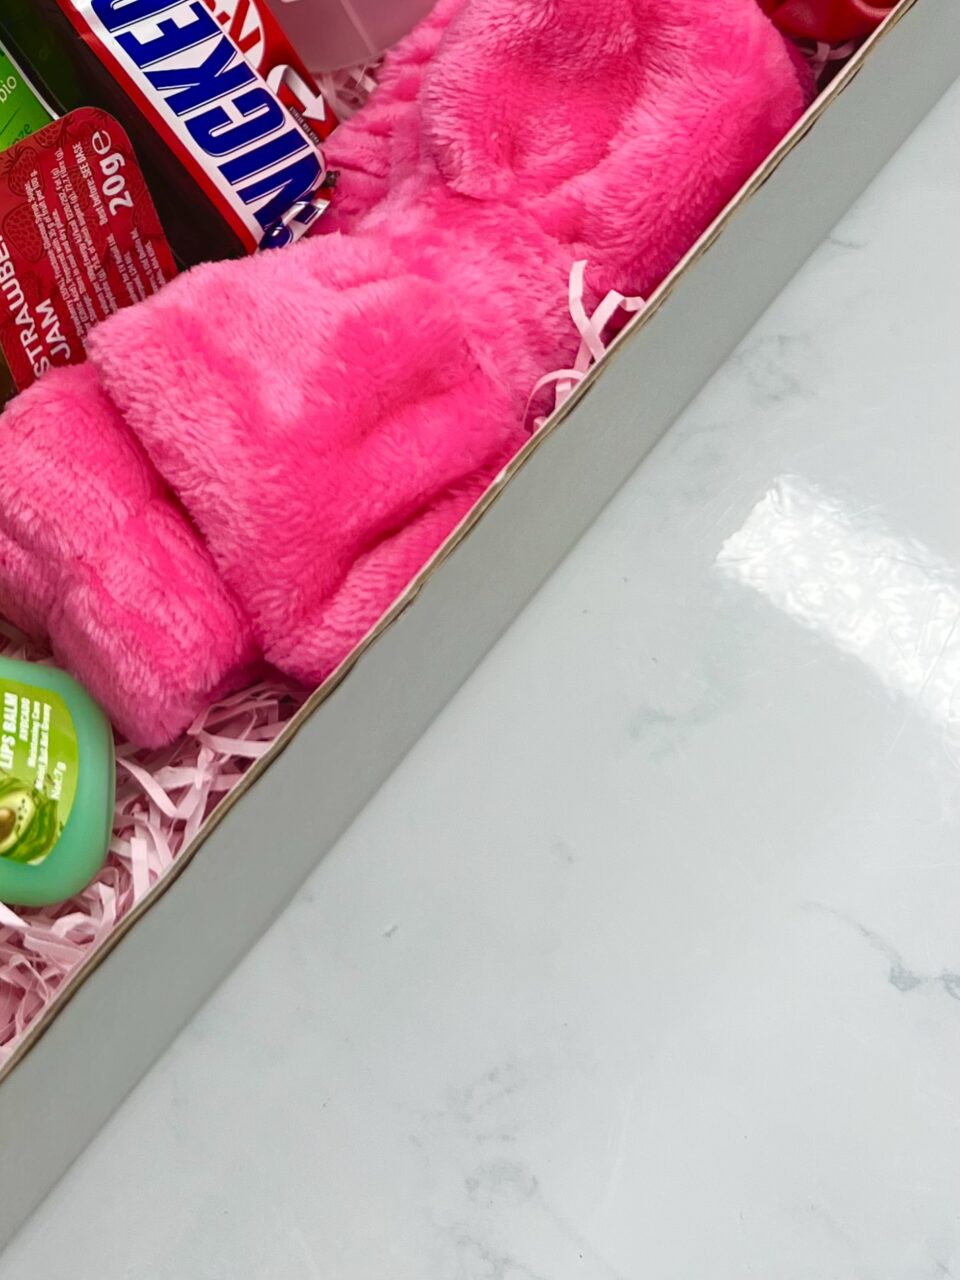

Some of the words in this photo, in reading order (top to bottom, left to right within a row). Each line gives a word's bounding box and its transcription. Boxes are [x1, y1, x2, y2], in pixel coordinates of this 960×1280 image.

[71, 141, 87, 163] BASE
[78, 161, 92, 178] SEE
[93, 150, 135, 216] 20g
[36, 298, 73, 374] JAM
[3, 692, 18, 733] BALM
[0, 734, 16, 770] LIPS
